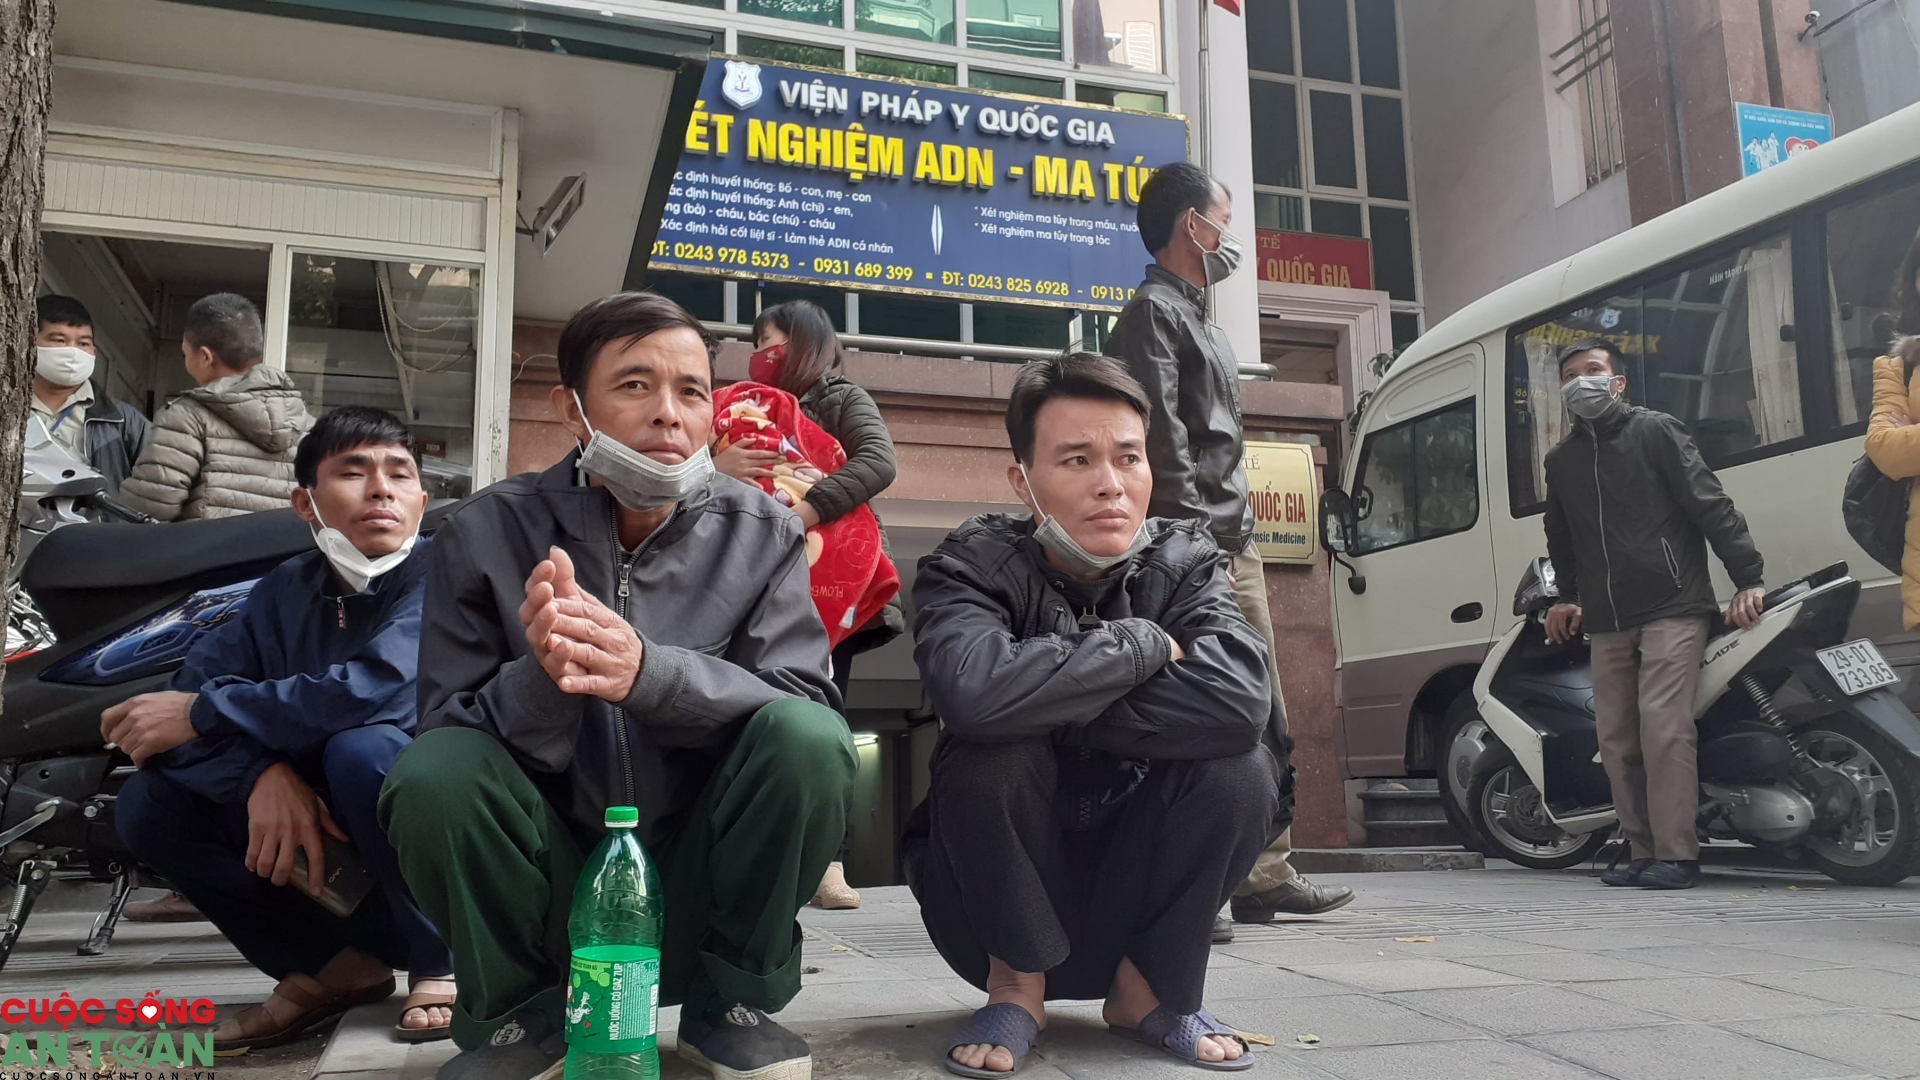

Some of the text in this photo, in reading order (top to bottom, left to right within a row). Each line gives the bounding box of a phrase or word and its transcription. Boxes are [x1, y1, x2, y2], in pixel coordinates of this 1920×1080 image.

[778, 78, 1115, 147] VIỆN PHÁP Y QUỐC GIA
[685, 100, 1160, 206] ÉT NGHIỆM ADN - MA TÚ
[685, 170, 709, 184] định
[711, 173, 741, 189] huyết
[743, 176, 776, 193] thống:
[778, 182, 792, 194] Bố
[801, 186, 824, 199] con,
[826, 189, 843, 201] mẹ
[852, 191, 872, 203] con
[685, 186, 709, 200] định
[711, 189, 741, 205] huyết
[743, 193, 776, 209] thống:
[778, 198, 799, 210] Anh
[801, 201, 825, 215] (chị)
[834, 206, 854, 218] em,
[716, 206, 746, 222] cháu,
[748, 210, 770, 223] bác
[772, 213, 800, 227] (chú)
[809, 217, 836, 231] cháu
[980, 206, 997, 217] Xét
[998, 209, 1034, 222] nghiệm
[1035, 215, 1051, 224] ma
[1053, 214, 1068, 227] túy
[1069, 216, 1094, 230] trong
[1095, 220, 1119, 232] máu,
[660, 218, 683, 231] Xác
[685, 221, 709, 235] định
[730, 225, 748, 239] cốt
[750, 227, 765, 242] liệt
[827, 237, 850, 250] ADN
[852, 239, 866, 251] cá
[868, 242, 894, 254] nhân
[980, 222, 1111, 246] Xét nghiệm ma túy trong tóc
[1260, 233, 1280, 250] TẾ
[674, 242, 714, 261] 0243
[718, 247, 747, 265] 978
[751, 250, 790, 269] 5373
[813, 257, 850, 275] 0931
[854, 261, 882, 279] 689
[885, 264, 913, 281] 399
[941, 270, 964, 287] ĐT:
[967, 273, 1003, 290] 0243
[1006, 277, 1032, 293] 825
[1035, 280, 1069, 296] 6928
[1090, 285, 1124, 301] 0913
[1266, 253, 1316, 285] QUỐC
[1320, 263, 1352, 288] GIA
[1285, 492, 1307, 524] GIA
[1250, 531, 1306, 545] ensic Medicine
[1837, 662, 1895, 691] 733.85
[613, 963, 623, 977] 7UP
[610, 991, 621, 1001] CÓ
[612, 977, 623, 991] GAZ
[608, 1001, 621, 1021] UỐNG
